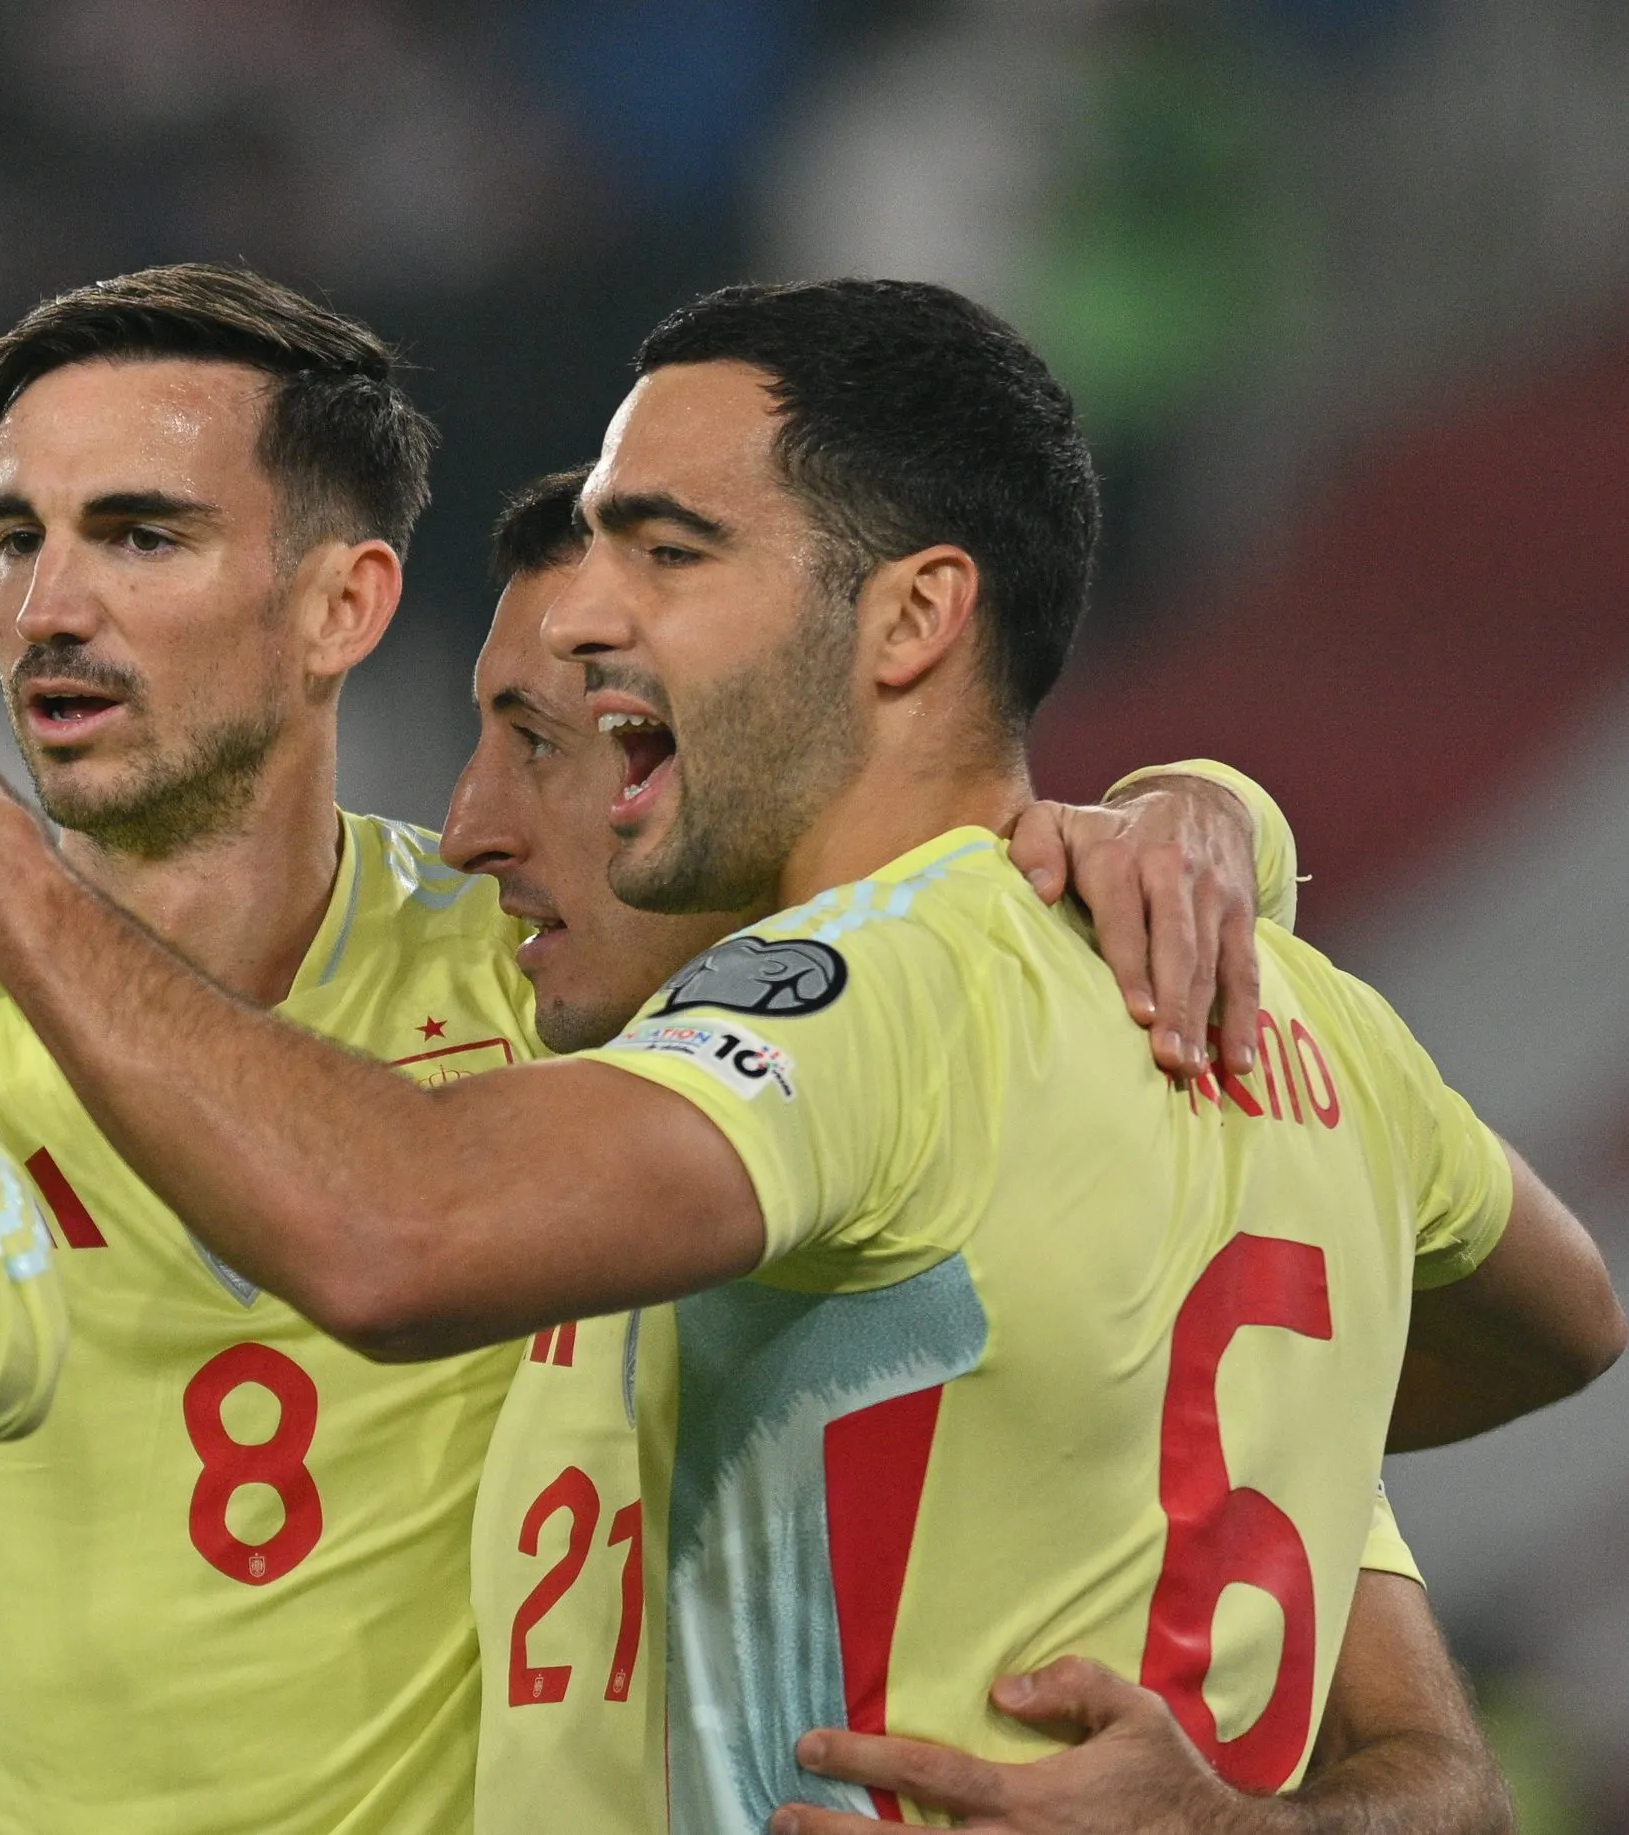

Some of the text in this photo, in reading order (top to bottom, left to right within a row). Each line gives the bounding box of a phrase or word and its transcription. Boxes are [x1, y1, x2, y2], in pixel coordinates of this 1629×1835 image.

[183, 1341, 323, 1586] 8
[508, 1465, 645, 1707] 21
[1139, 1232, 1332, 1797] 6
